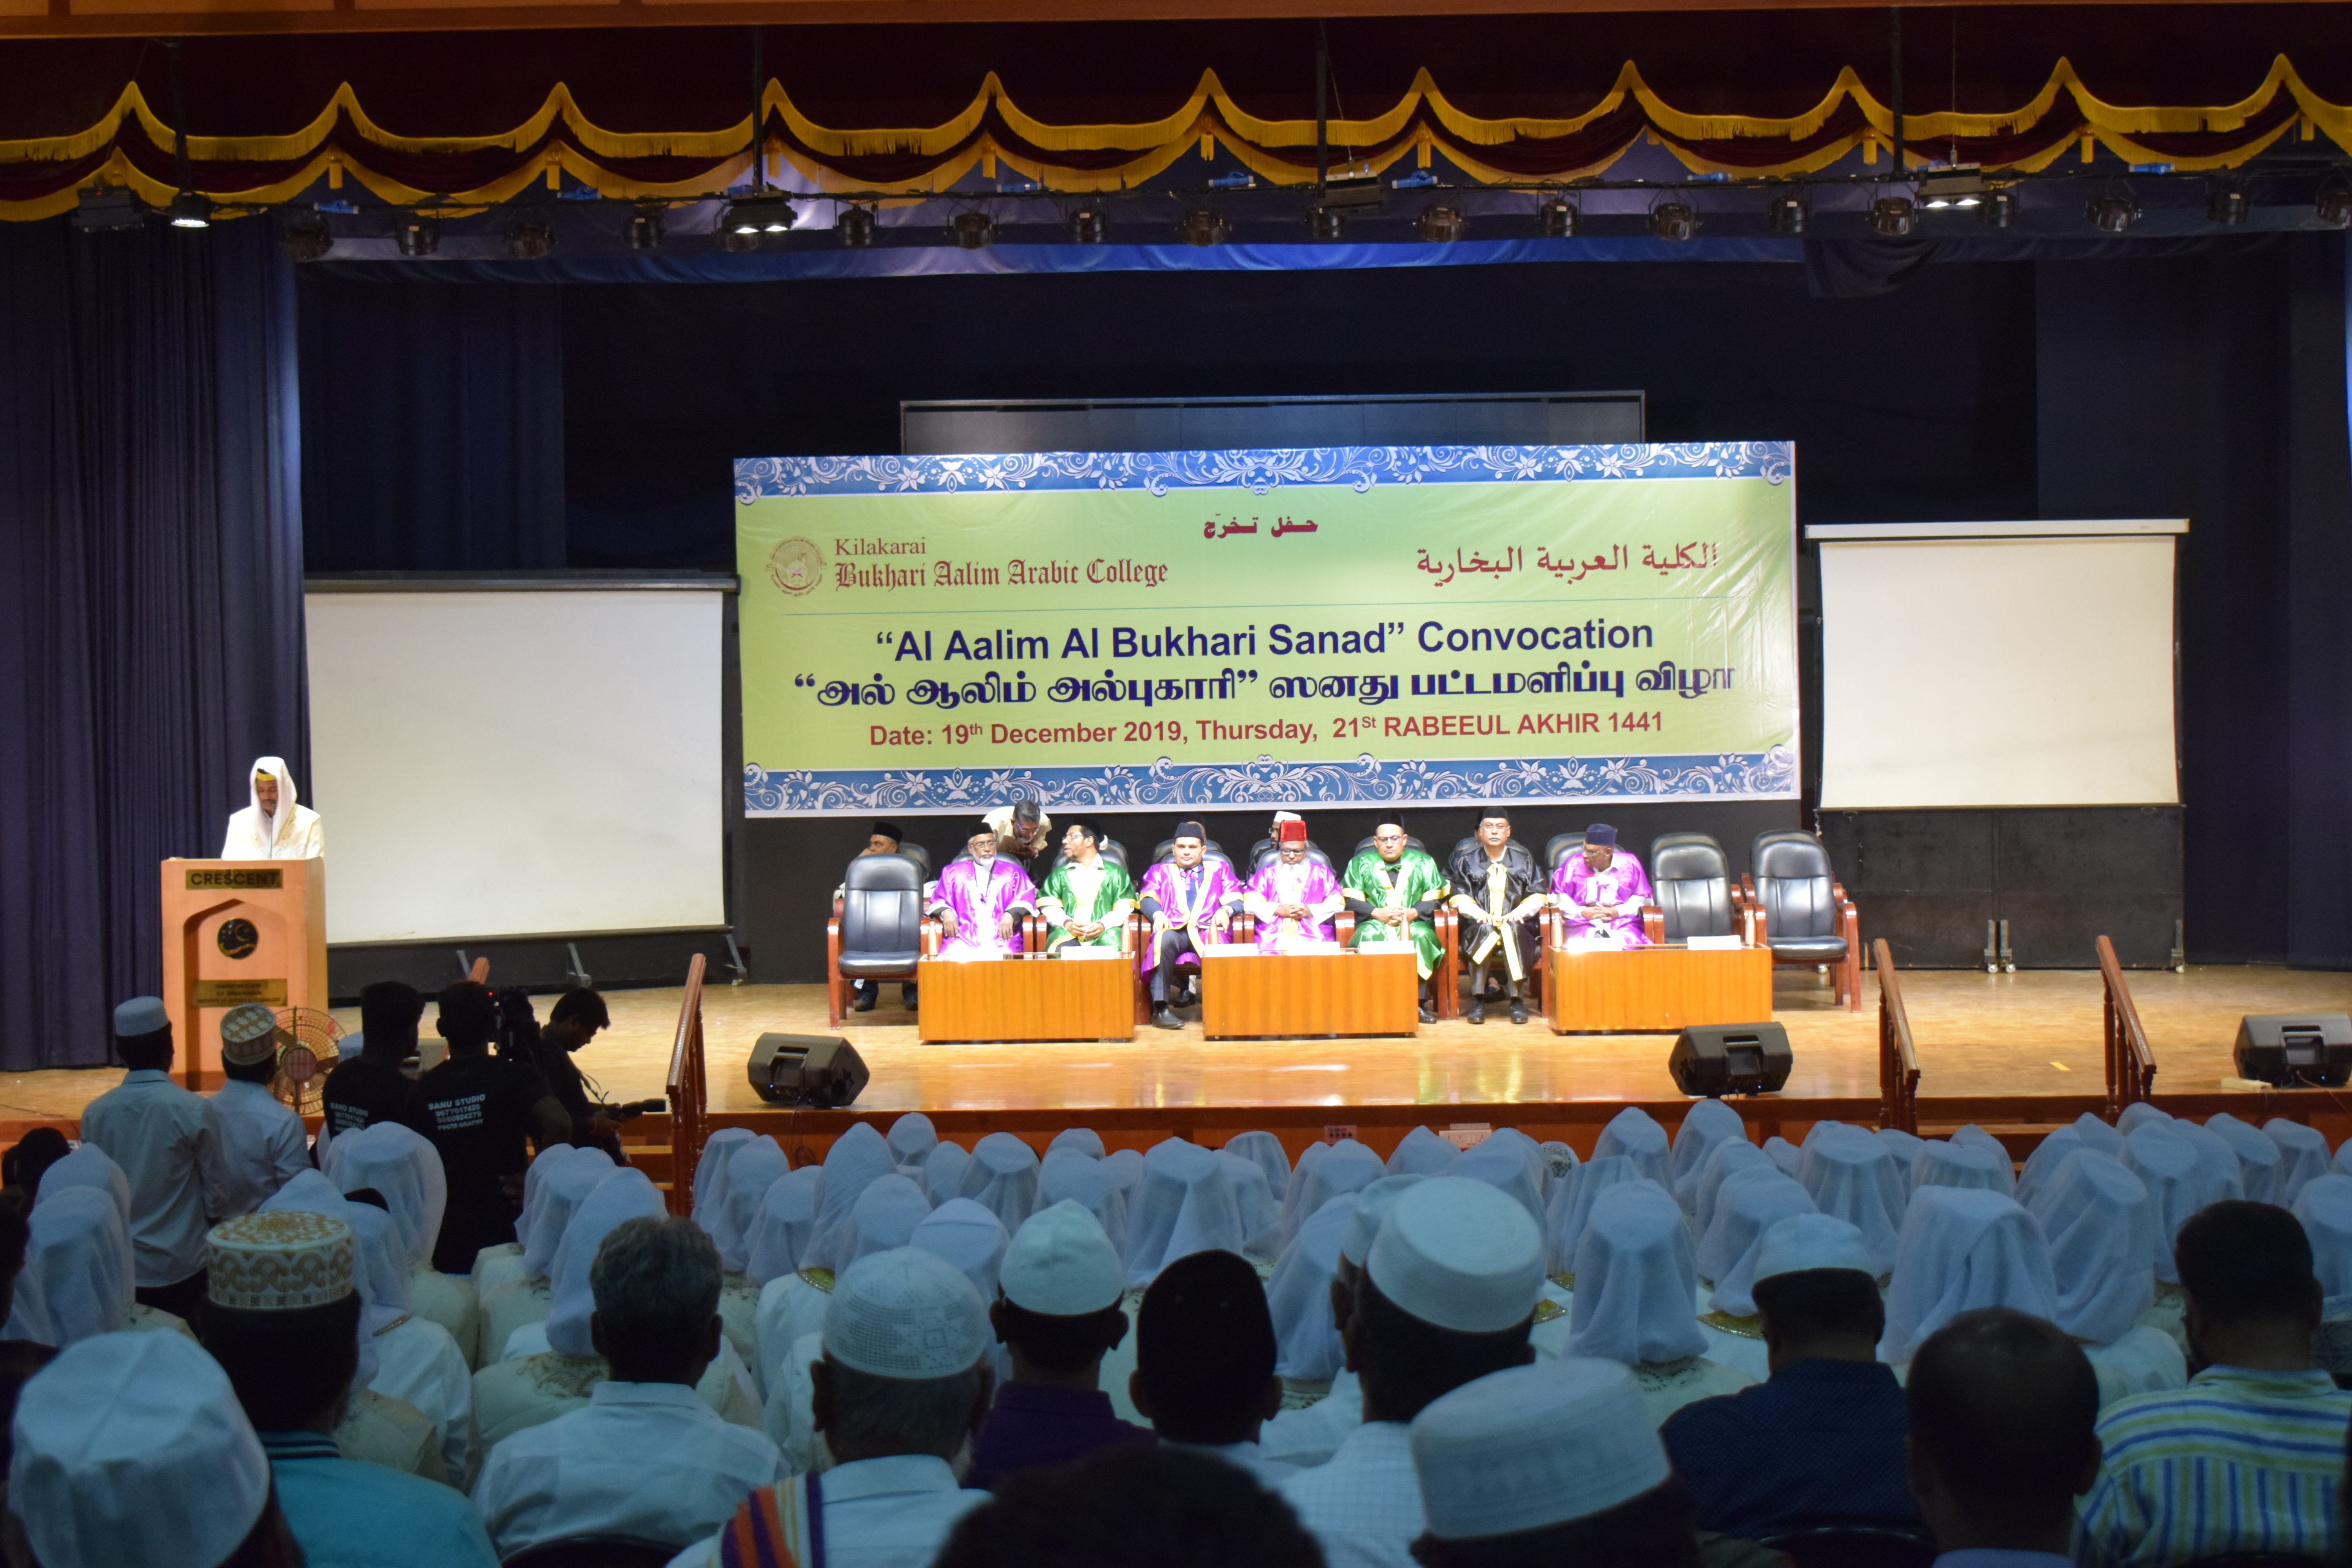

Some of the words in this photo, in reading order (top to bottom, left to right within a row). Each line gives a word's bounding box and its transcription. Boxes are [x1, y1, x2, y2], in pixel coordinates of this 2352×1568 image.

[1271, 516, 1319, 538] حفل
[835, 538, 926, 556] Kilakarai
[1537, 543, 1628, 585] العربية
[1642, 541, 1717, 576] الكلية
[835, 562, 926, 592] Bukhari
[934, 560, 1000, 586] Aalim
[1008, 558, 1079, 585] Arabic
[1086, 558, 1168, 588] College
[1417, 545, 1523, 587] البخارية
[877, 630, 932, 662] “Al
[944, 629, 1049, 661] Aalim
[1061, 627, 1098, 659] Al
[1112, 624, 1256, 658] Bukhari
[1269, 622, 1404, 655] Sanad”
[1418, 618, 1653, 652] Convocation
[906, 670, 1037, 710] ஆலிம்
[1411, 660, 1624, 698] பட்டமளிப்பு
[1635, 660, 1735, 699] விழா
[870, 725, 932, 746] Date:
[942, 723, 983, 745] 19th
[991, 722, 1117, 744] December
[1124, 720, 1188, 745] 2019,
[1196, 719, 1317, 744] Thursday,
[1384, 715, 1510, 737] RABEEUL
[1517, 713, 1600, 734] AKHIR
[1608, 711, 1661, 732] 1441
[191, 873, 279, 885] CRESCENT
[428, 1101, 452, 1110] BANU
[454, 1094, 486, 1106] STUDIO
